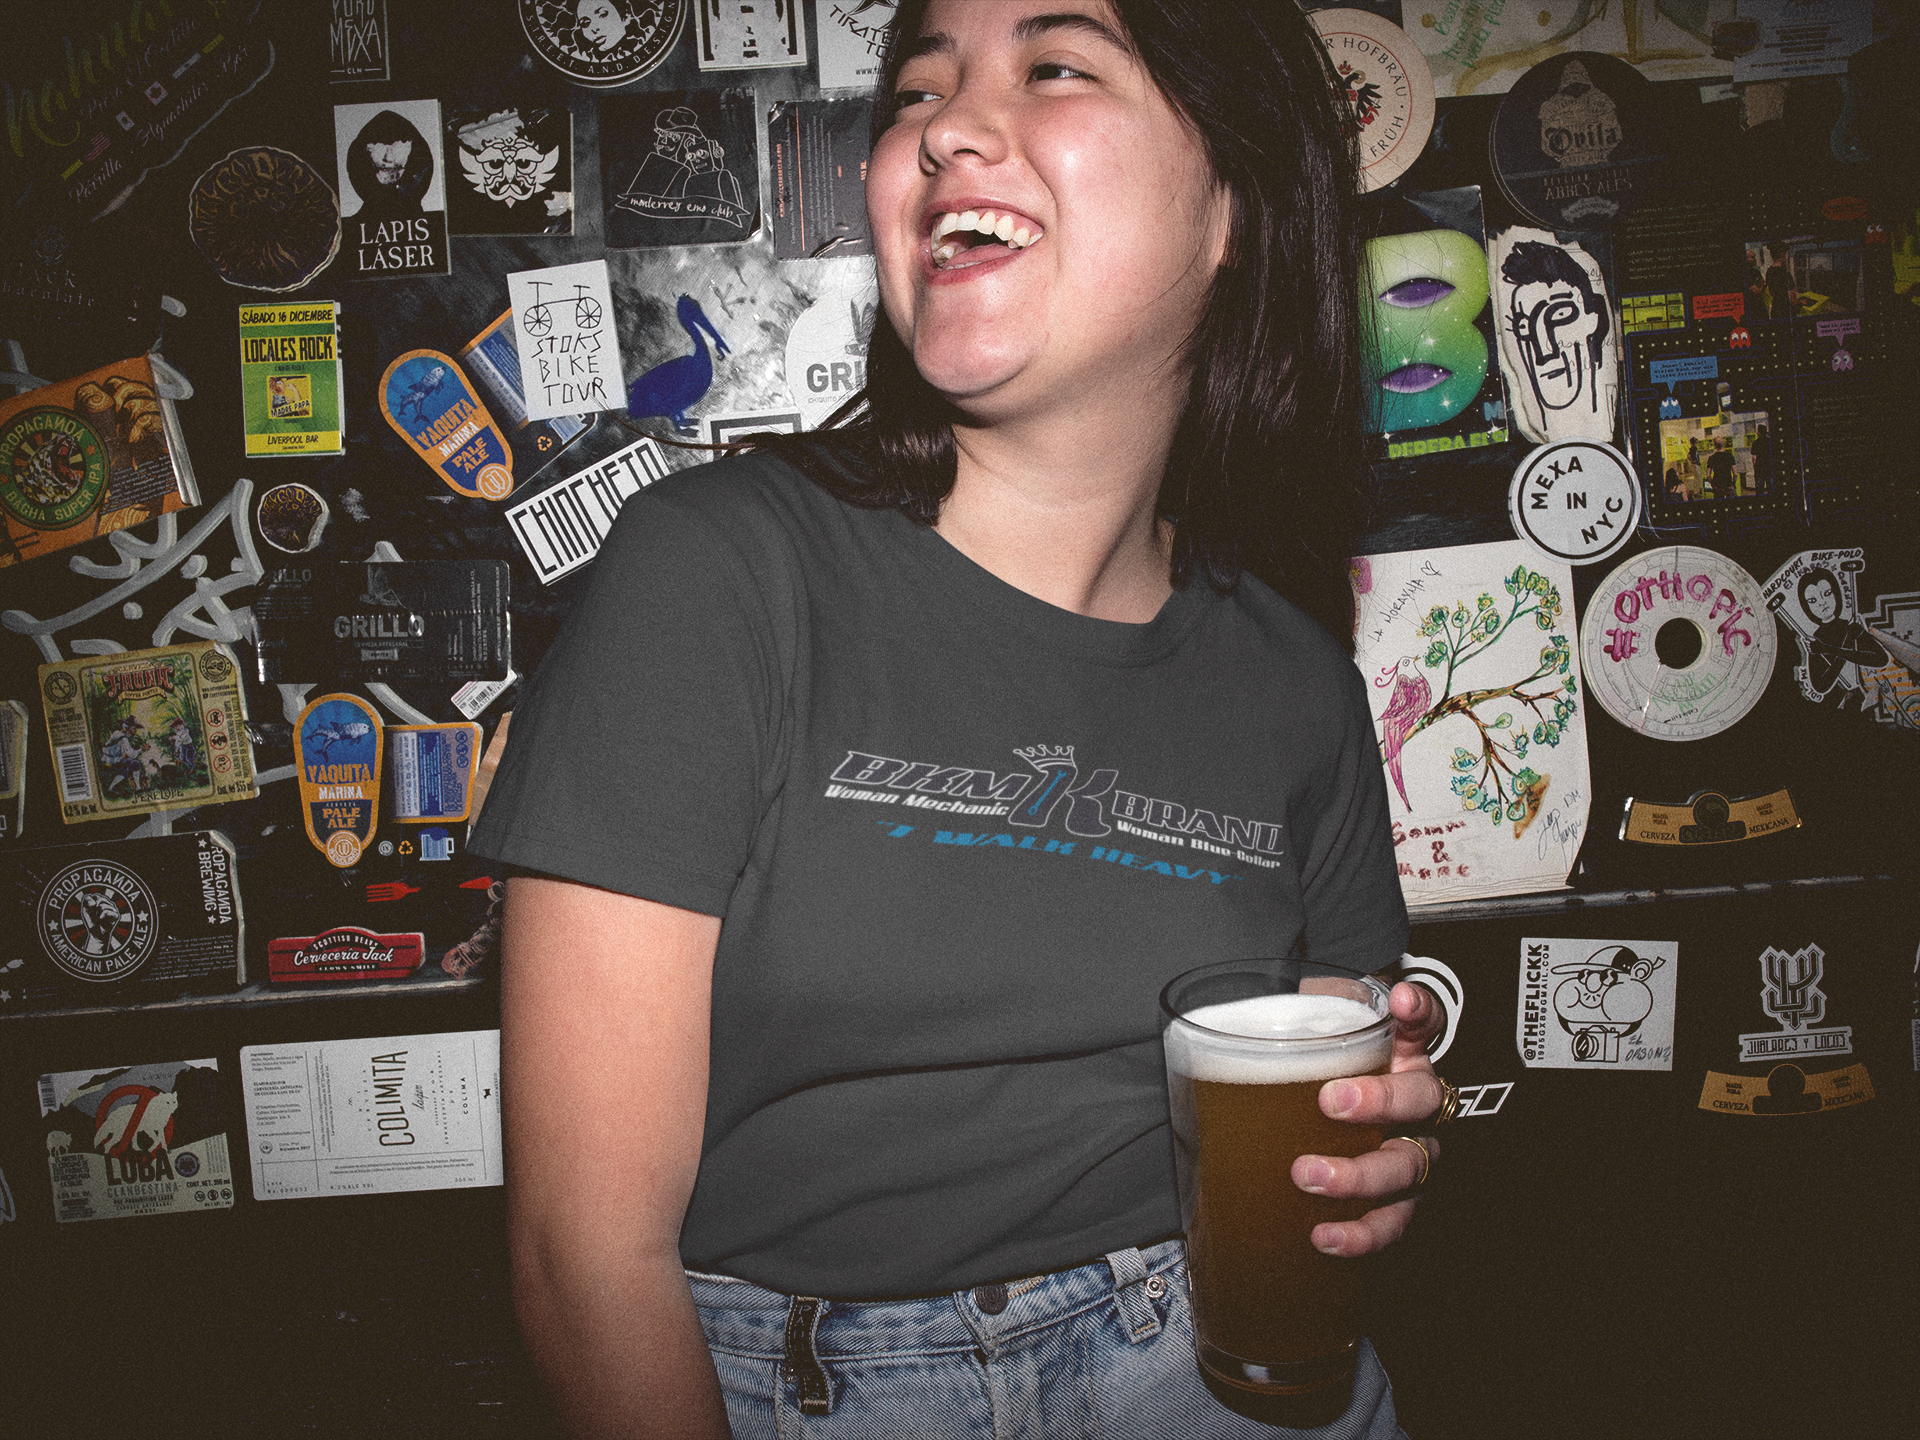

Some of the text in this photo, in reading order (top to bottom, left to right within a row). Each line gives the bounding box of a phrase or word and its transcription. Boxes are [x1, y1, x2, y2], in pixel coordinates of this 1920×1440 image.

[360, 218, 430, 245] LAPIS
[358, 244, 435, 271] LÁSER
[242, 309, 333, 324] SÁBADO 16 DICIEMBRE
[244, 336, 333, 363] LOCALES ROCK
[539, 355, 600, 382] BIKE
[544, 377, 607, 406] TOUR
[416, 398, 478, 451] VAQUITA
[268, 434, 319, 445] LIVERPOOL BAR
[438, 420, 481, 458] MARINA
[452, 436, 488, 468] PALE
[464, 449, 491, 474] ALE
[54, 490, 94, 520] SUPER
[87, 462, 102, 484] IPA
[1531, 456, 1583, 510] MEXA
[1566, 491, 1587, 510] IN
[1580, 496, 1624, 545] NYC
[1763, 550, 1862, 599] HARDCOURT BIKE-POLO
[334, 614, 425, 639] GRILLO
[307, 762, 372, 784] VAQUITA
[318, 785, 364, 801] MARINA
[824, 784, 1010, 816] Woman Mechanic
[322, 807, 361, 819] PALE
[327, 817, 357, 829] ALE
[933, 829, 1078, 855] WALK
[1639, 830, 1676, 841] CERVEZA
[1749, 817, 1790, 834] MEXICANA
[1117, 820, 1281, 869] Woman Blue-Collar
[49, 867, 141, 910] PROPAGANDA
[198, 851, 217, 912] BREWING
[210, 844, 232, 924] ROPAGANDA
[51, 933, 102, 972] AMERICAN
[106, 948, 136, 973] PALE
[132, 924, 149, 949] ALE
[313, 933, 351, 951] SCOTTISH
[361, 946, 394, 964] Jack
[1523, 943, 1543, 1061] @THEFLICKK
[1538, 944, 1550, 1061] 1995GXB@GMAIL.COM
[371, 1050, 415, 1148] COLIMITA
[411, 1084, 424, 1112] lager
[460, 1077, 469, 1115] COLIMA
[1712, 1091, 1866, 1111] CERVEZA MEXICANA
[105, 1147, 175, 1187] LOBA
[107, 1181, 180, 1199] CLANDESTINA
